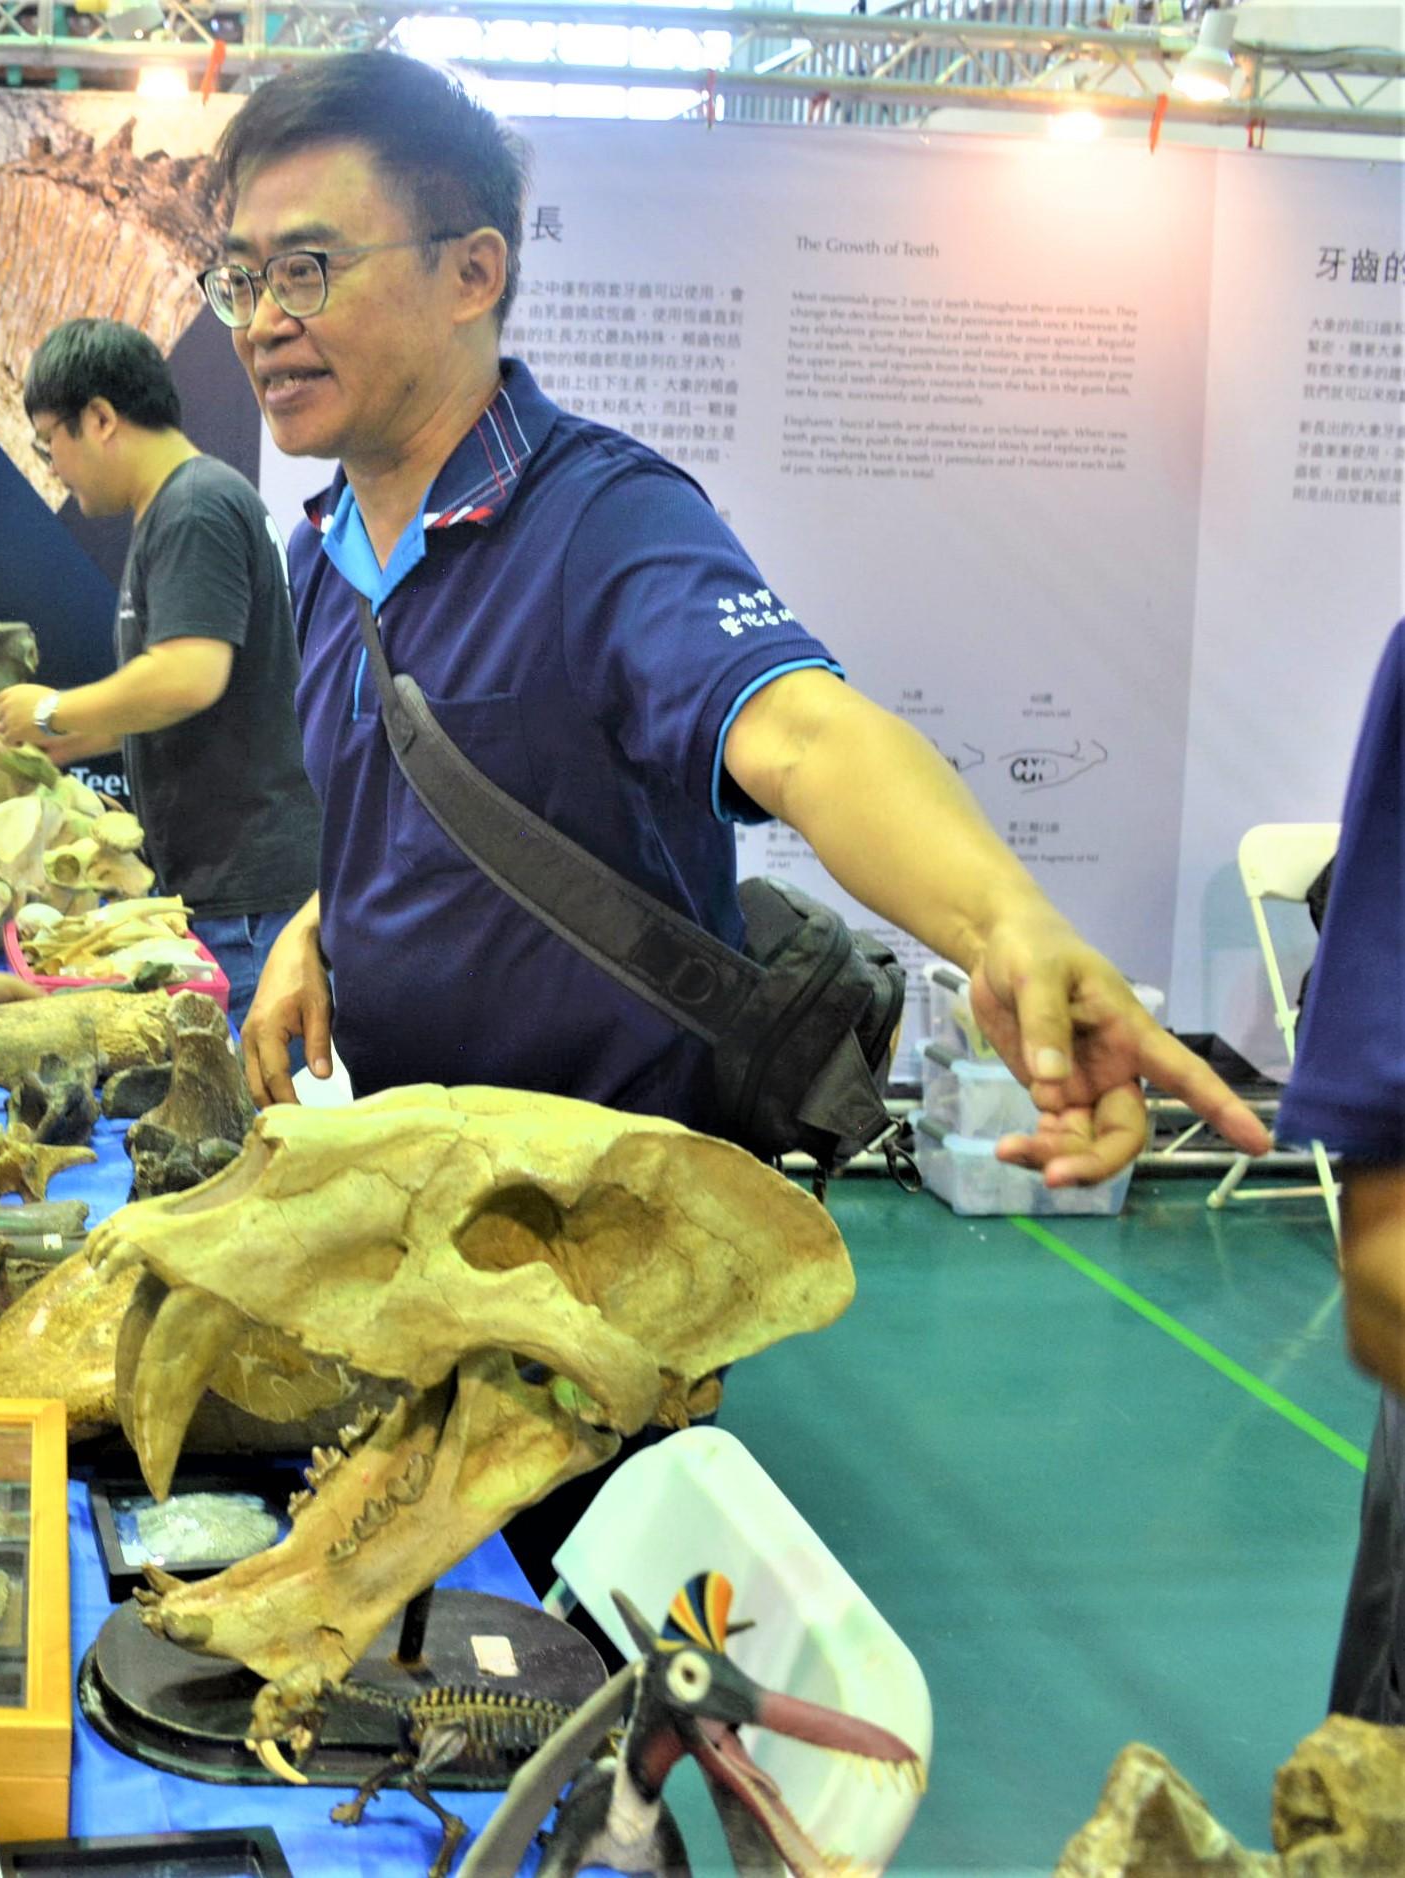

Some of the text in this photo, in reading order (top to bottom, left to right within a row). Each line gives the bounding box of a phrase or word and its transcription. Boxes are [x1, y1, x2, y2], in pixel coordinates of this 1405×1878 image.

[796, 235, 940, 259] The Growth of Teeth
